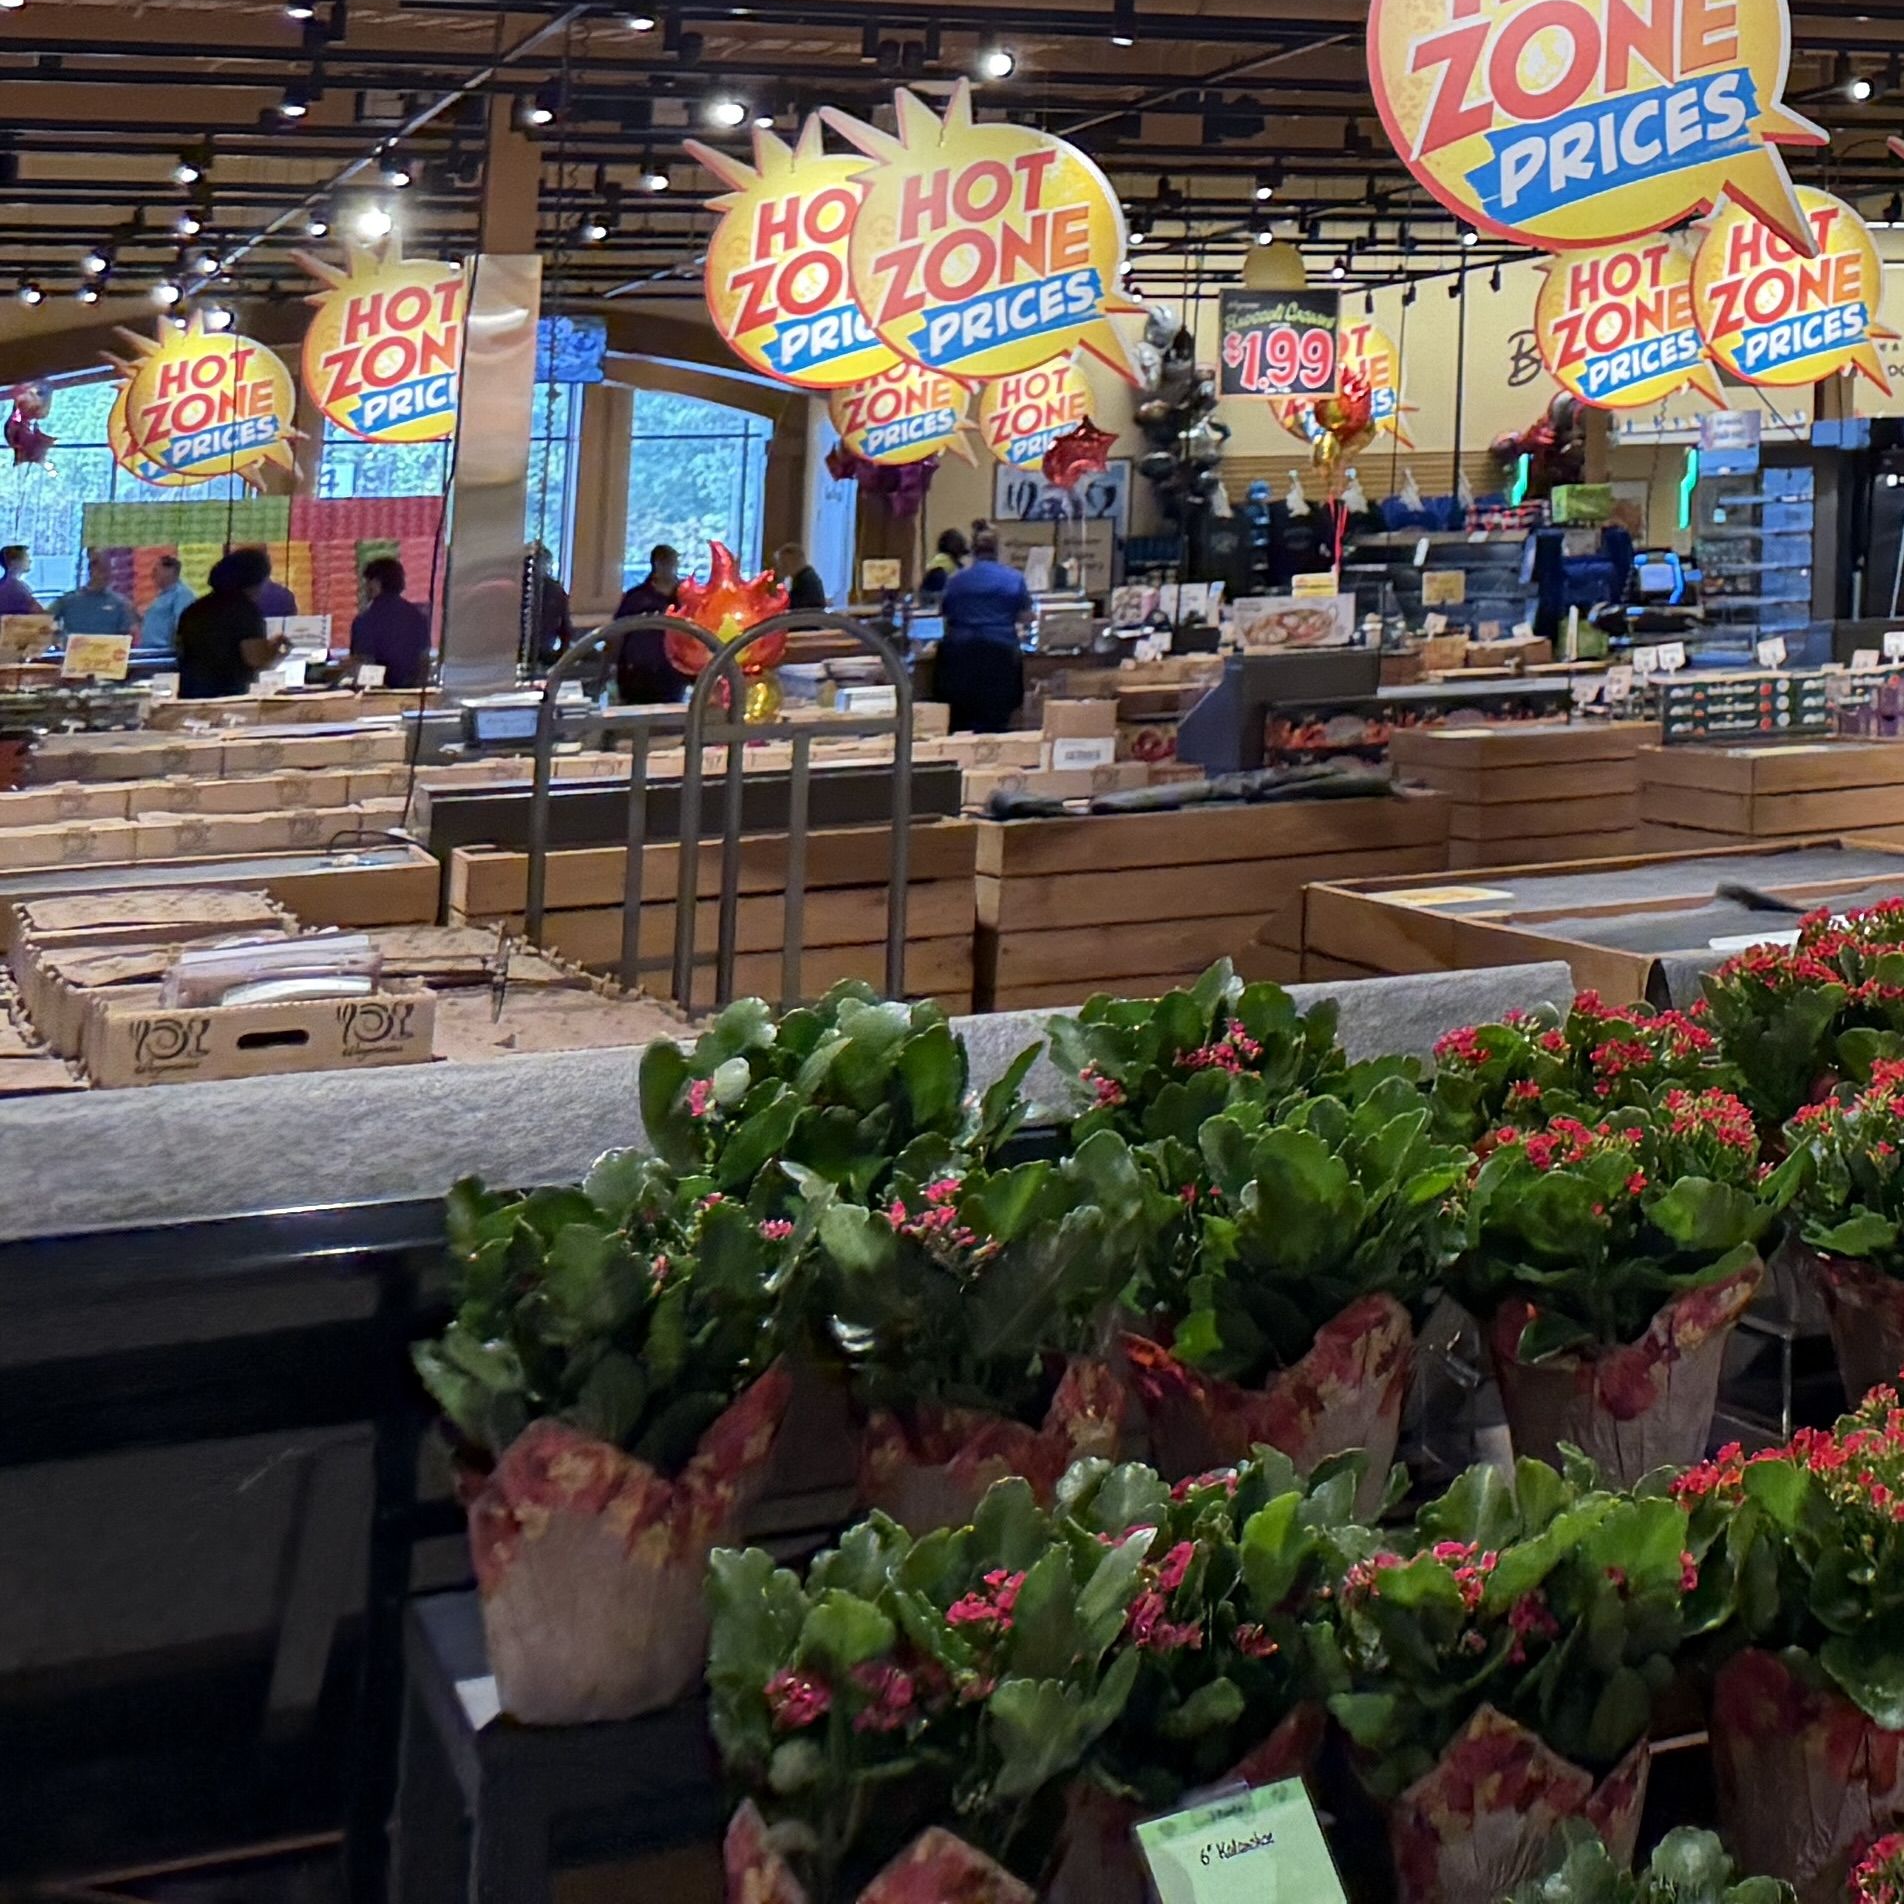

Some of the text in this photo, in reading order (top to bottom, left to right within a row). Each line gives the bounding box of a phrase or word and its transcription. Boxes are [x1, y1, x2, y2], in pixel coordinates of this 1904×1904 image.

[1500, 69, 1756, 207] PRICES
[755, 188, 859, 262] HO
[899, 149, 1056, 241] HOT
[729, 250, 853, 337] ZO
[871, 206, 1090, 328] ZONE
[1569, 244, 1669, 311] HOT
[1709, 253, 1862, 341] ZONE
[344, 279, 464, 345] HOT
[780, 310, 877, 367] PRIC
[929, 271, 1099, 358] PRICES
[1552, 284, 1693, 370] ZONE
[1745, 307, 1865, 368] PRICES
[158, 348, 257, 400] HOT
[323, 325, 457, 406] ZON
[998, 367, 1071, 409] HOT
[1222, 327, 1334, 391] $1.99
[1588, 330, 1697, 394] PRICES
[142, 379, 274, 447] ZONE
[364, 375, 457, 428] PRIC
[843, 380, 950, 436] ZONE
[867, 409, 955, 454] PRICES
[989, 392, 1086, 446] ZONE
[172, 416, 274, 465] PRICES
[1013, 423, 1077, 461] PRI
